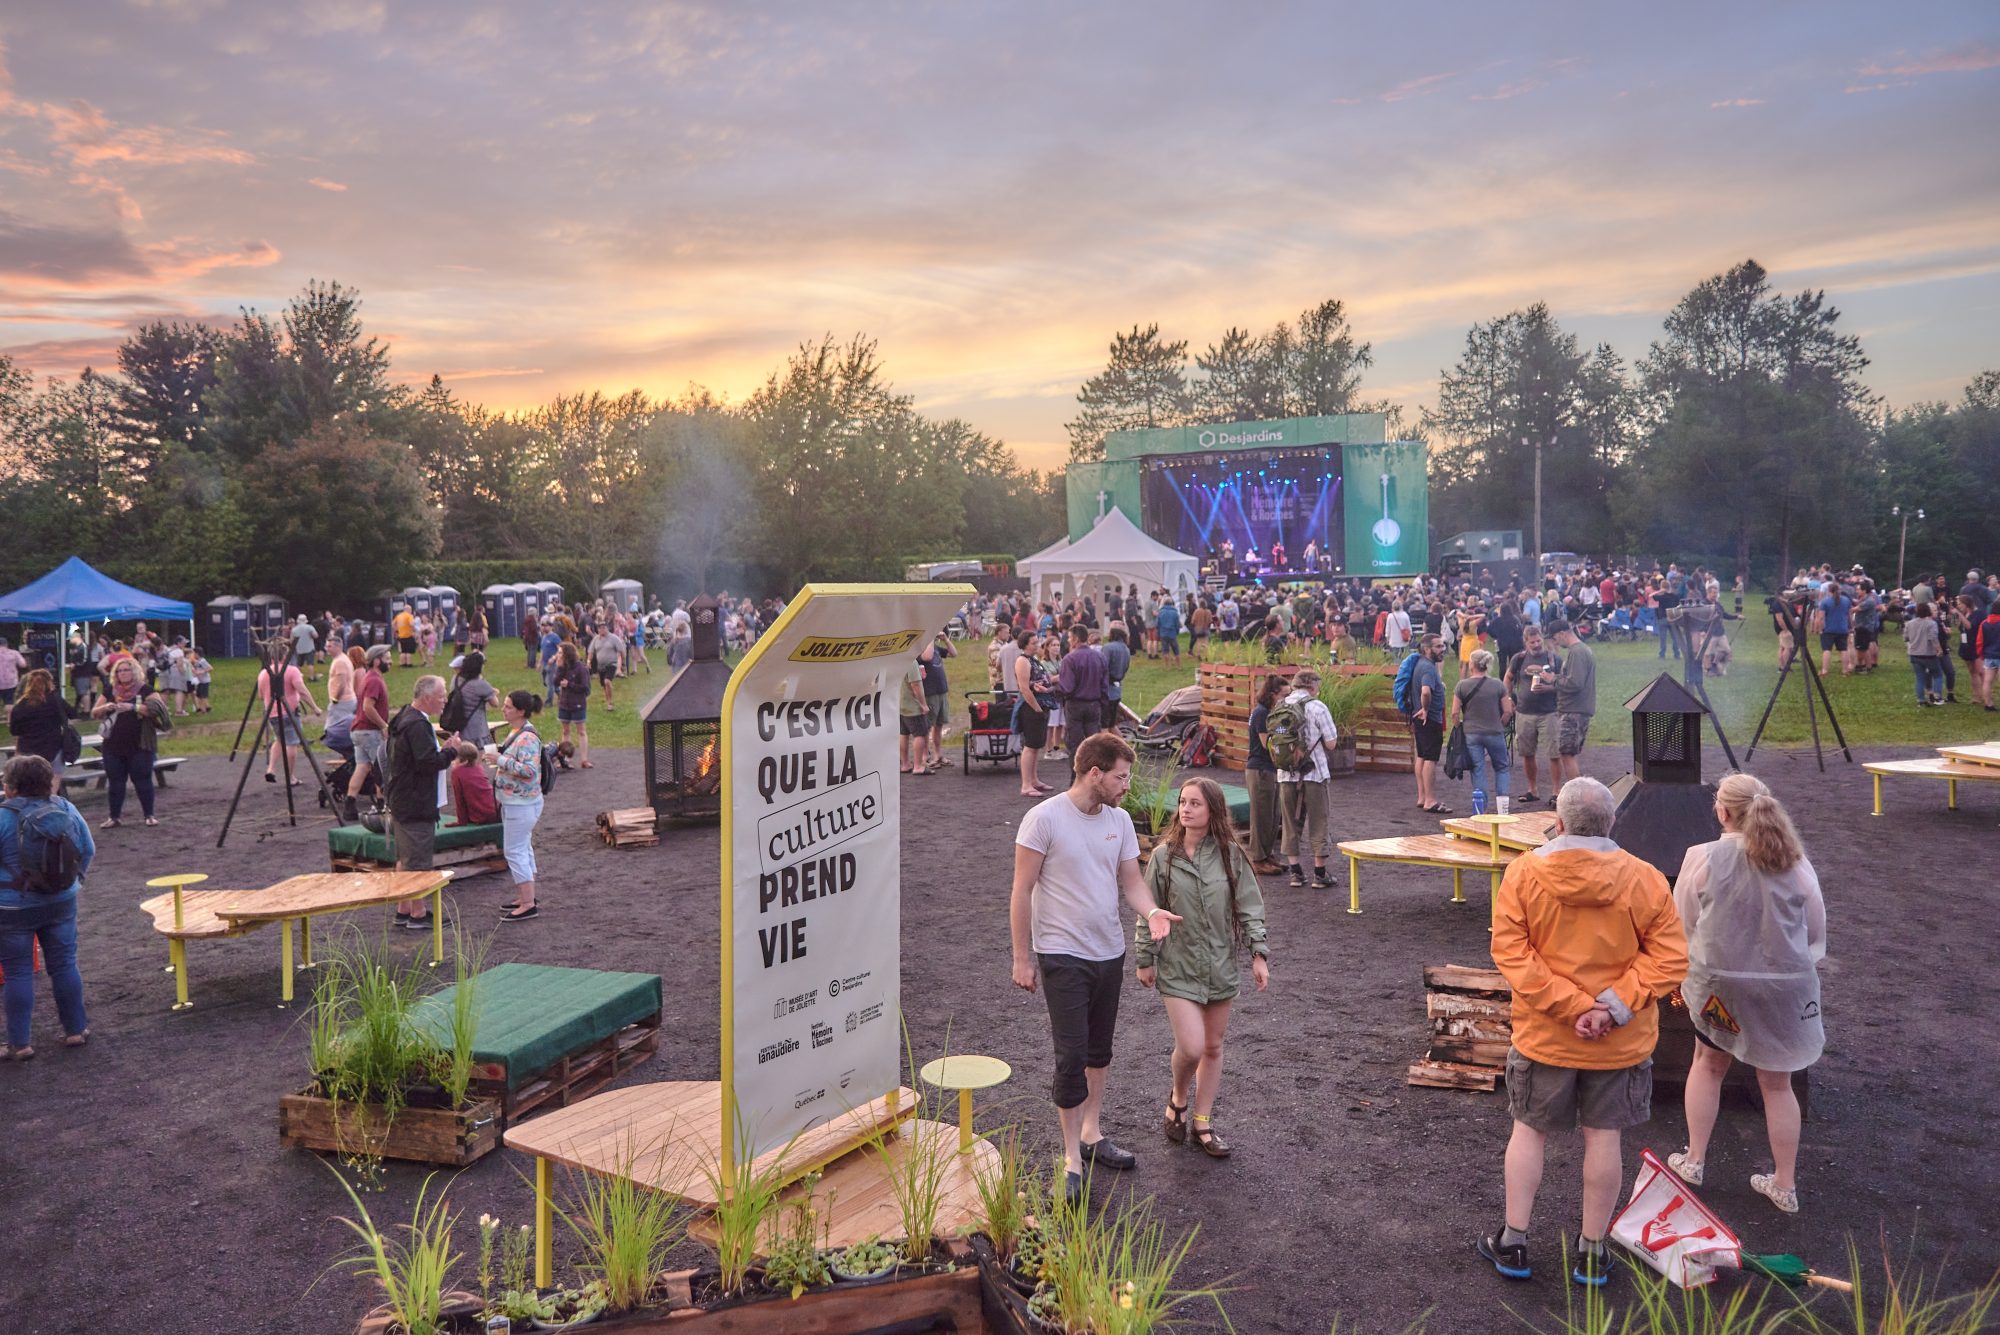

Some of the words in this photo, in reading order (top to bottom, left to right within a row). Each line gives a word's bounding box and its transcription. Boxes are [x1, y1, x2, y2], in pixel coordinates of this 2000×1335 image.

[1219, 430, 1283, 445] Desjardins
[801, 641, 869, 657] JOLIETTE
[757, 698, 841, 742] C'EST
[845, 691, 881, 731] ICI
[758, 750, 817, 804] QUE
[827, 745, 857, 787] LA
[769, 795, 875, 860] culture
[760, 852, 856, 913] PREND
[758, 917, 807, 968] VIE
[842, 976, 856, 985] Centre
[842, 980, 863, 991] Desjardins
[789, 993, 804, 1006] MUSÉE
[805, 989, 818, 1000] D'ART
[788, 1005, 795, 1014] DE
[796, 998, 816, 1011] JOLIETTE
[811, 1026, 832, 1040] Mémoire
[795, 1095, 816, 1109] Québec
